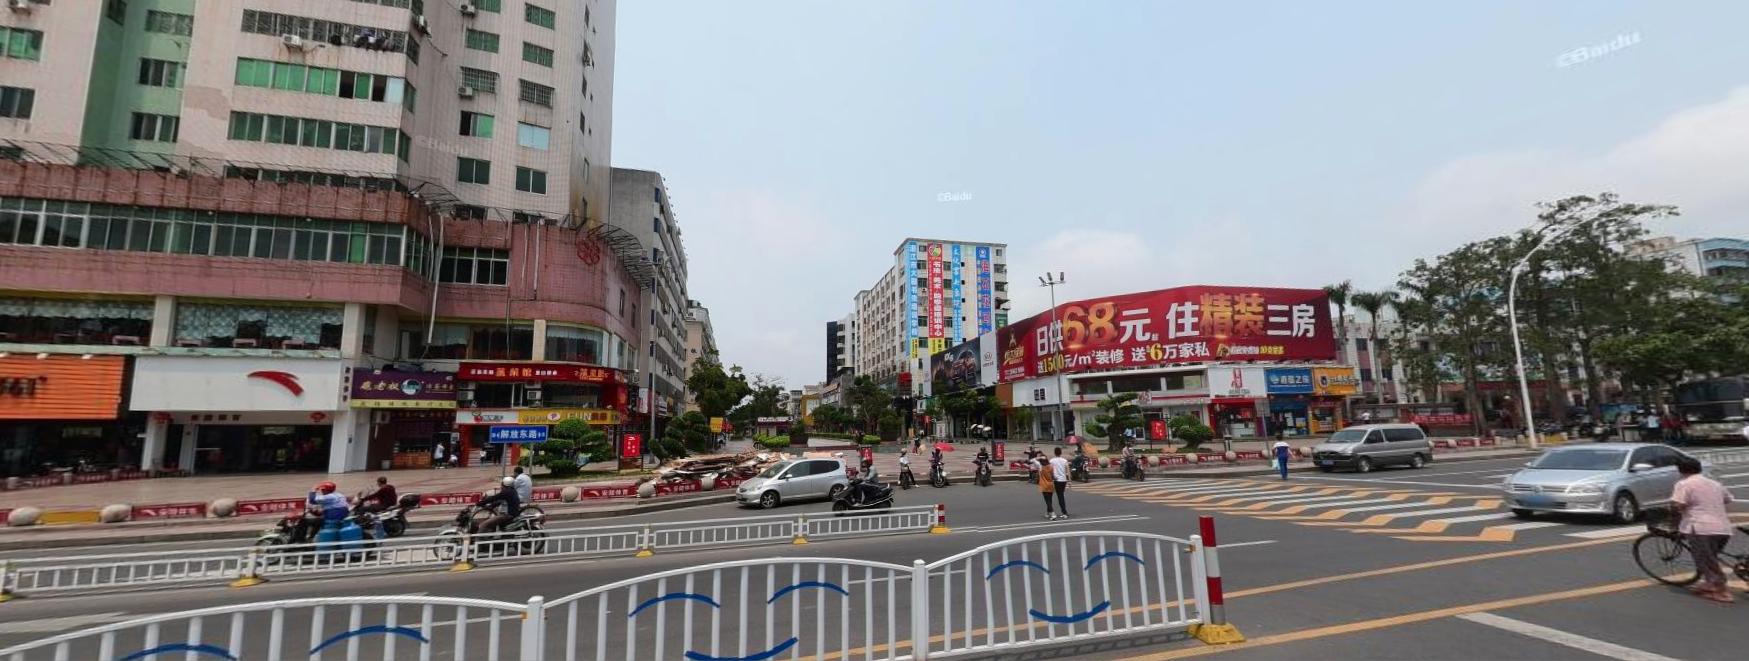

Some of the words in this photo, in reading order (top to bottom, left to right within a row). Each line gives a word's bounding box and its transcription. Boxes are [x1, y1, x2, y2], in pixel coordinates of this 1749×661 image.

[1165, 292, 1316, 339] 住精装三房
[500, 429, 537, 439] 解放东路
